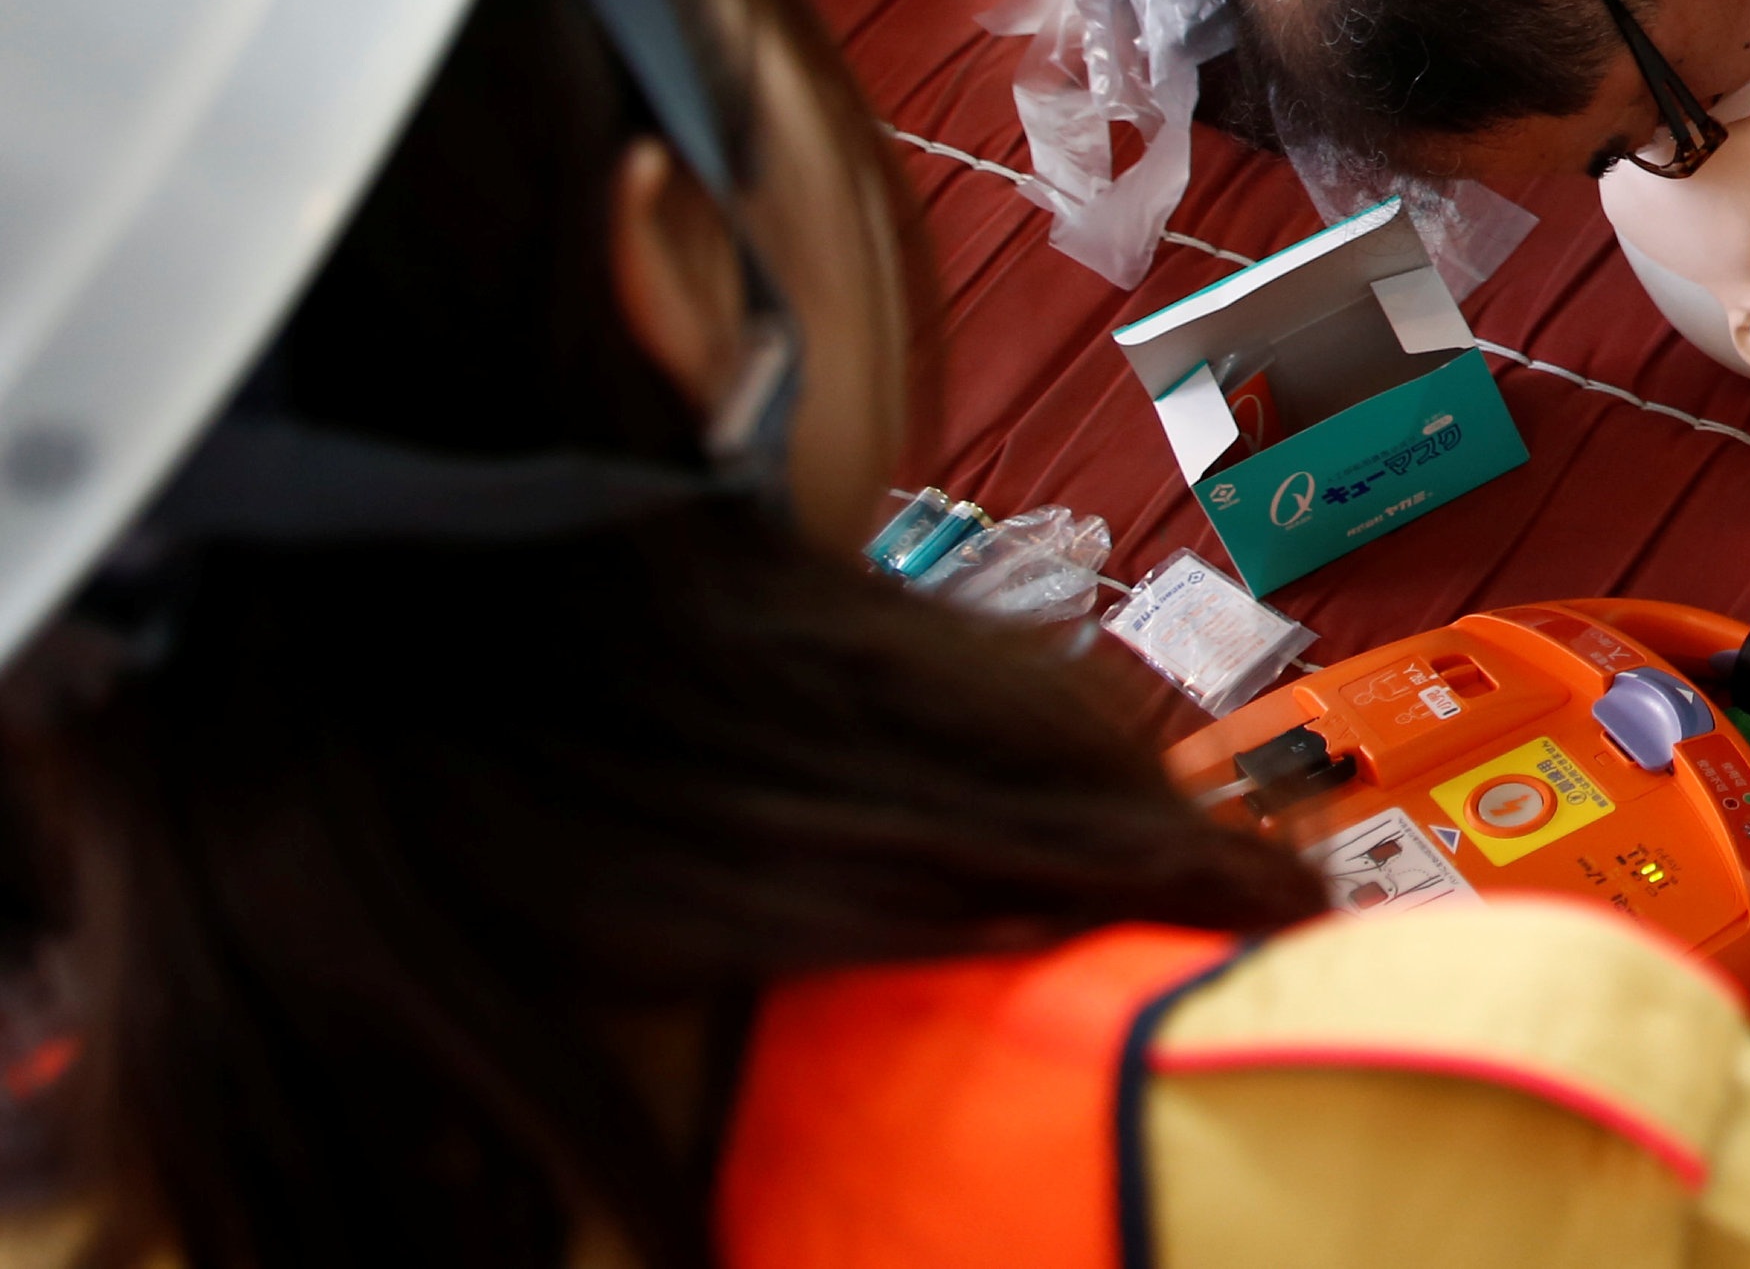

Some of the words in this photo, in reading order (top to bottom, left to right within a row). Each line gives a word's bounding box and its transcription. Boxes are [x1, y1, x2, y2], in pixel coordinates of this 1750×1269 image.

[1269, 470, 1316, 527] Q
[1321, 423, 1463, 506] キューマスク
